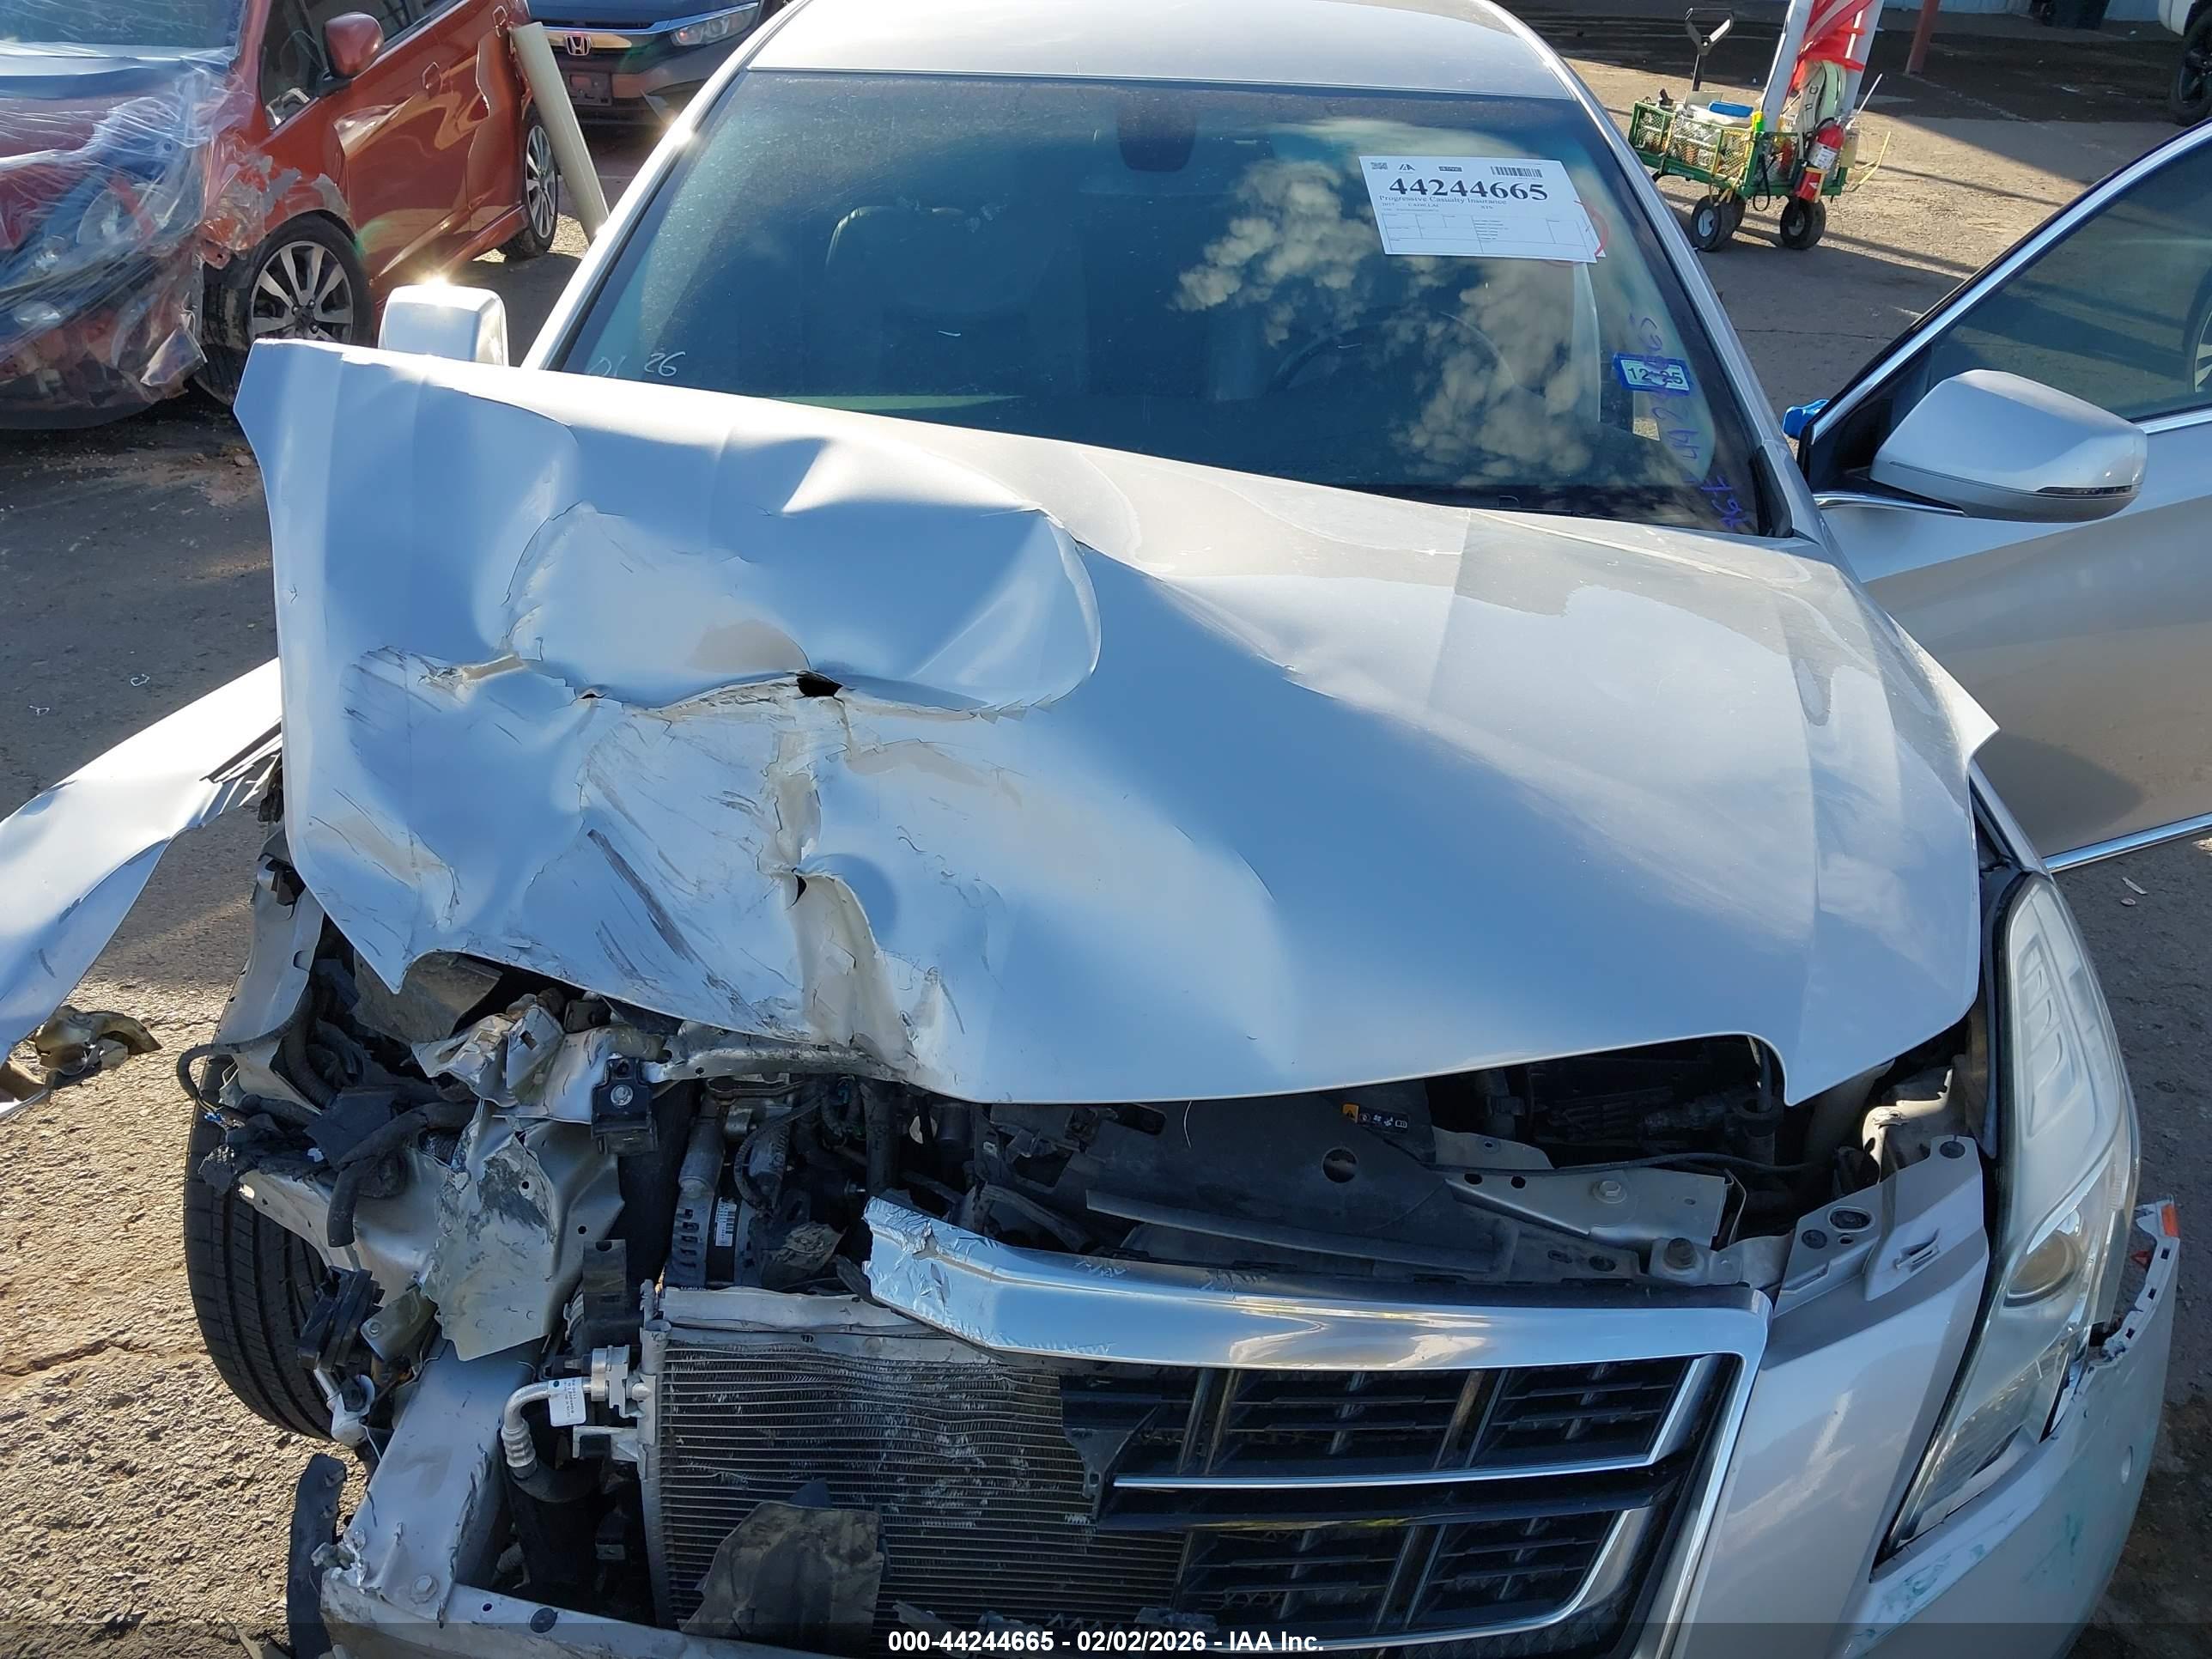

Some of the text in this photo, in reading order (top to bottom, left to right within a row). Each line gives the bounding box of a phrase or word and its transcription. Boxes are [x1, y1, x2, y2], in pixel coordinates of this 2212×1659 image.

[1389, 178, 1548, 201] 44244665
[644, 351, 686, 376] 26
[1627, 368, 1652, 380] 12
